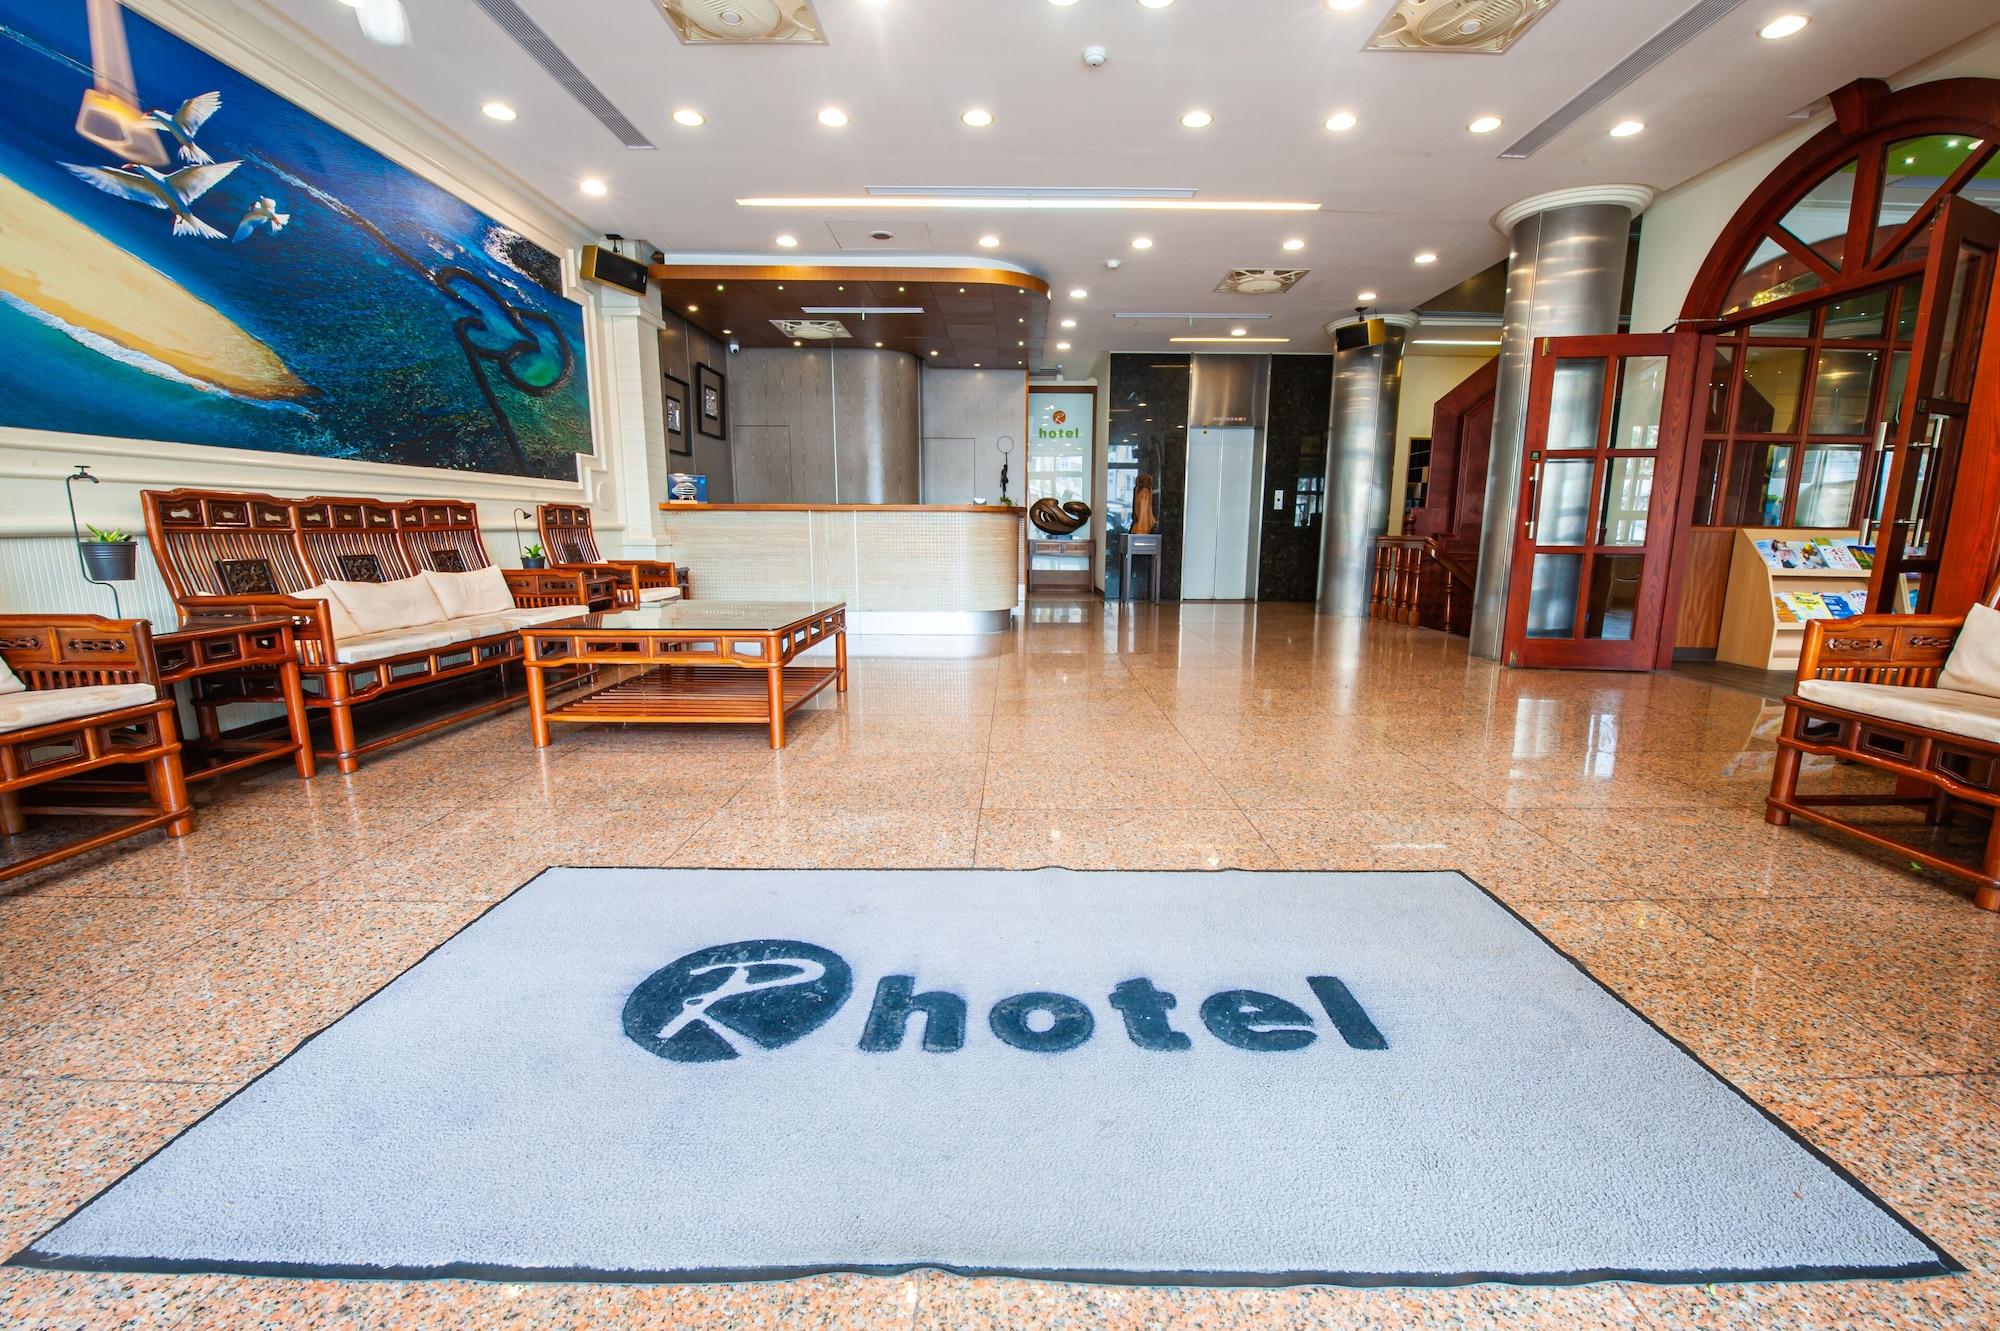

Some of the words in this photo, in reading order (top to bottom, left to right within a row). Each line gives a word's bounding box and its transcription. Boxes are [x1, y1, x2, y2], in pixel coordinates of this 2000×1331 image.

[1039, 428, 1079, 439] hotel
[652, 954, 830, 1060] R
[857, 975, 1389, 1053] hotel
